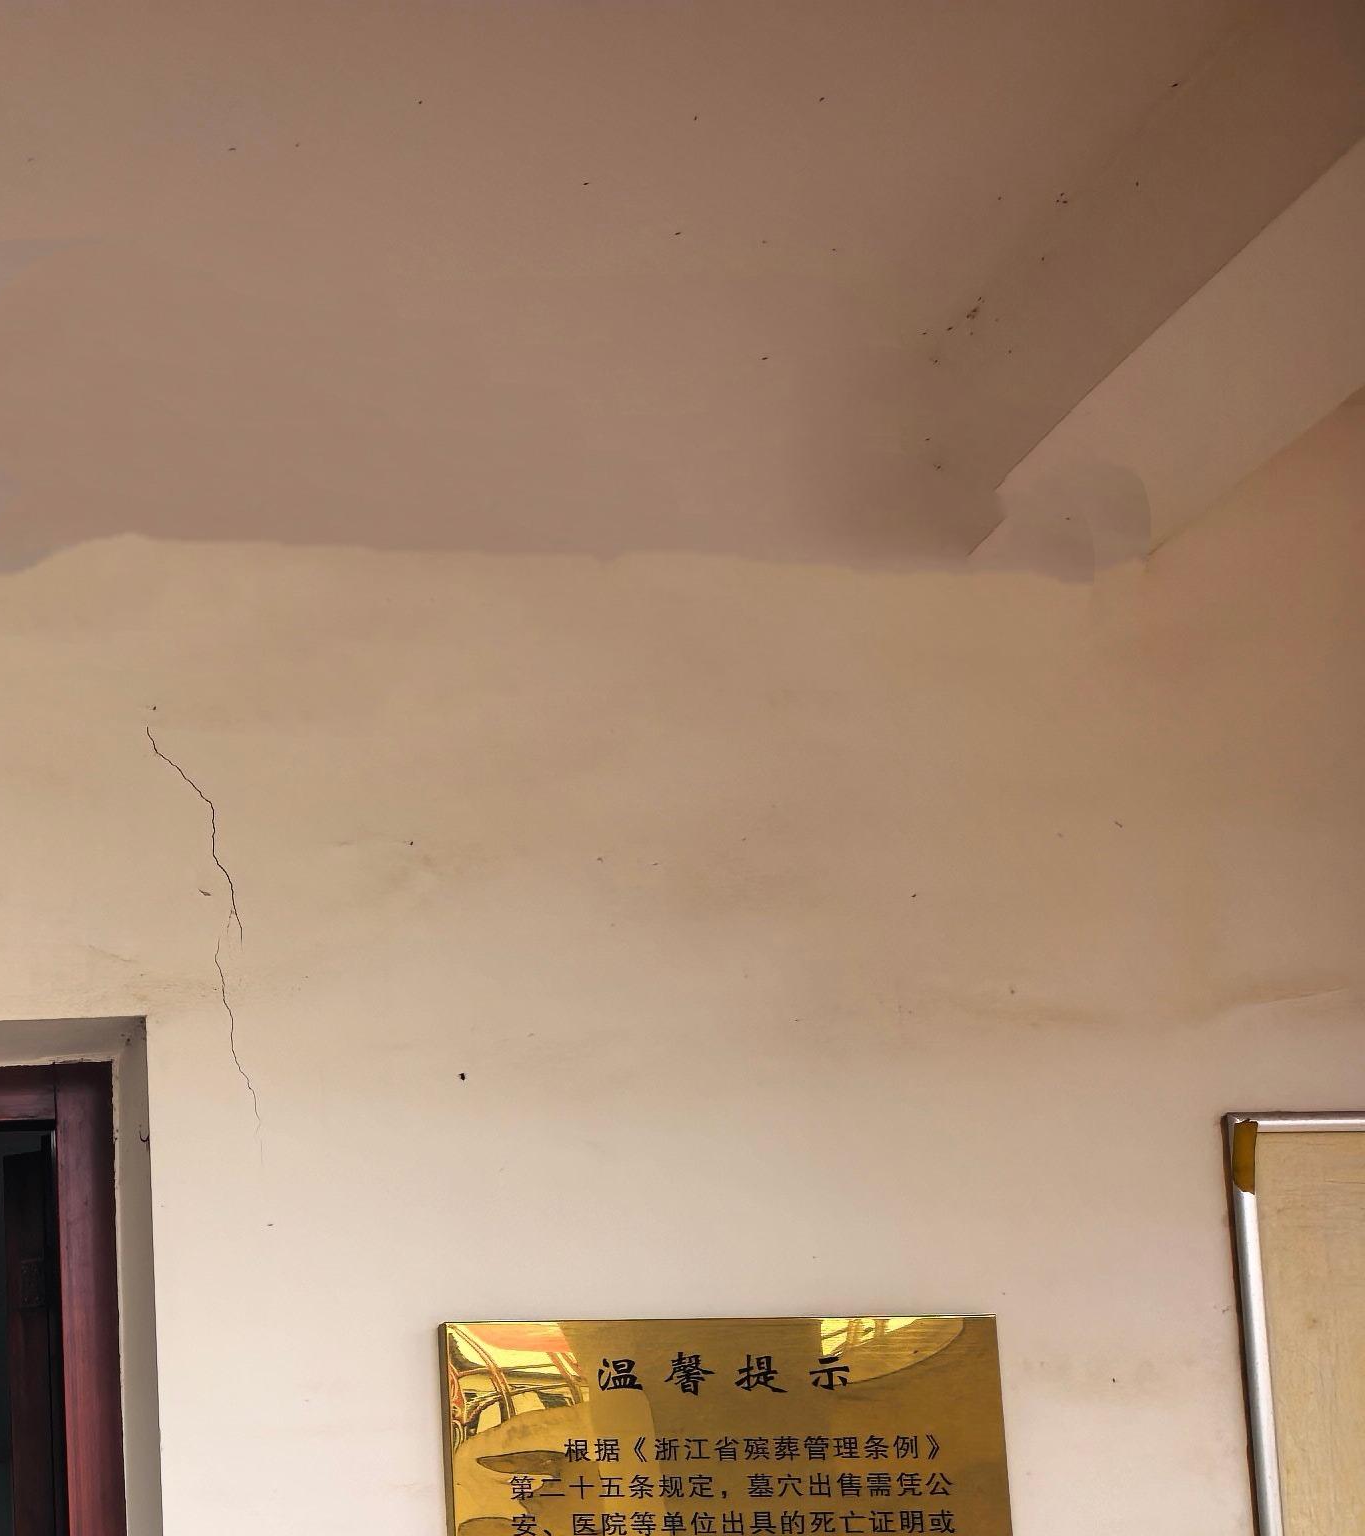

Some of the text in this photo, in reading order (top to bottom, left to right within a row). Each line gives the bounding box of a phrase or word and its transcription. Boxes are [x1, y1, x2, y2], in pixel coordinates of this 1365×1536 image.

[597, 1351, 855, 1397] 温馨提示
[563, 1433, 943, 1465] 根据《浙江省殡葬管理条例》
[509, 1471, 954, 1501] 第二十五条规定，墓穴出售需凭公
